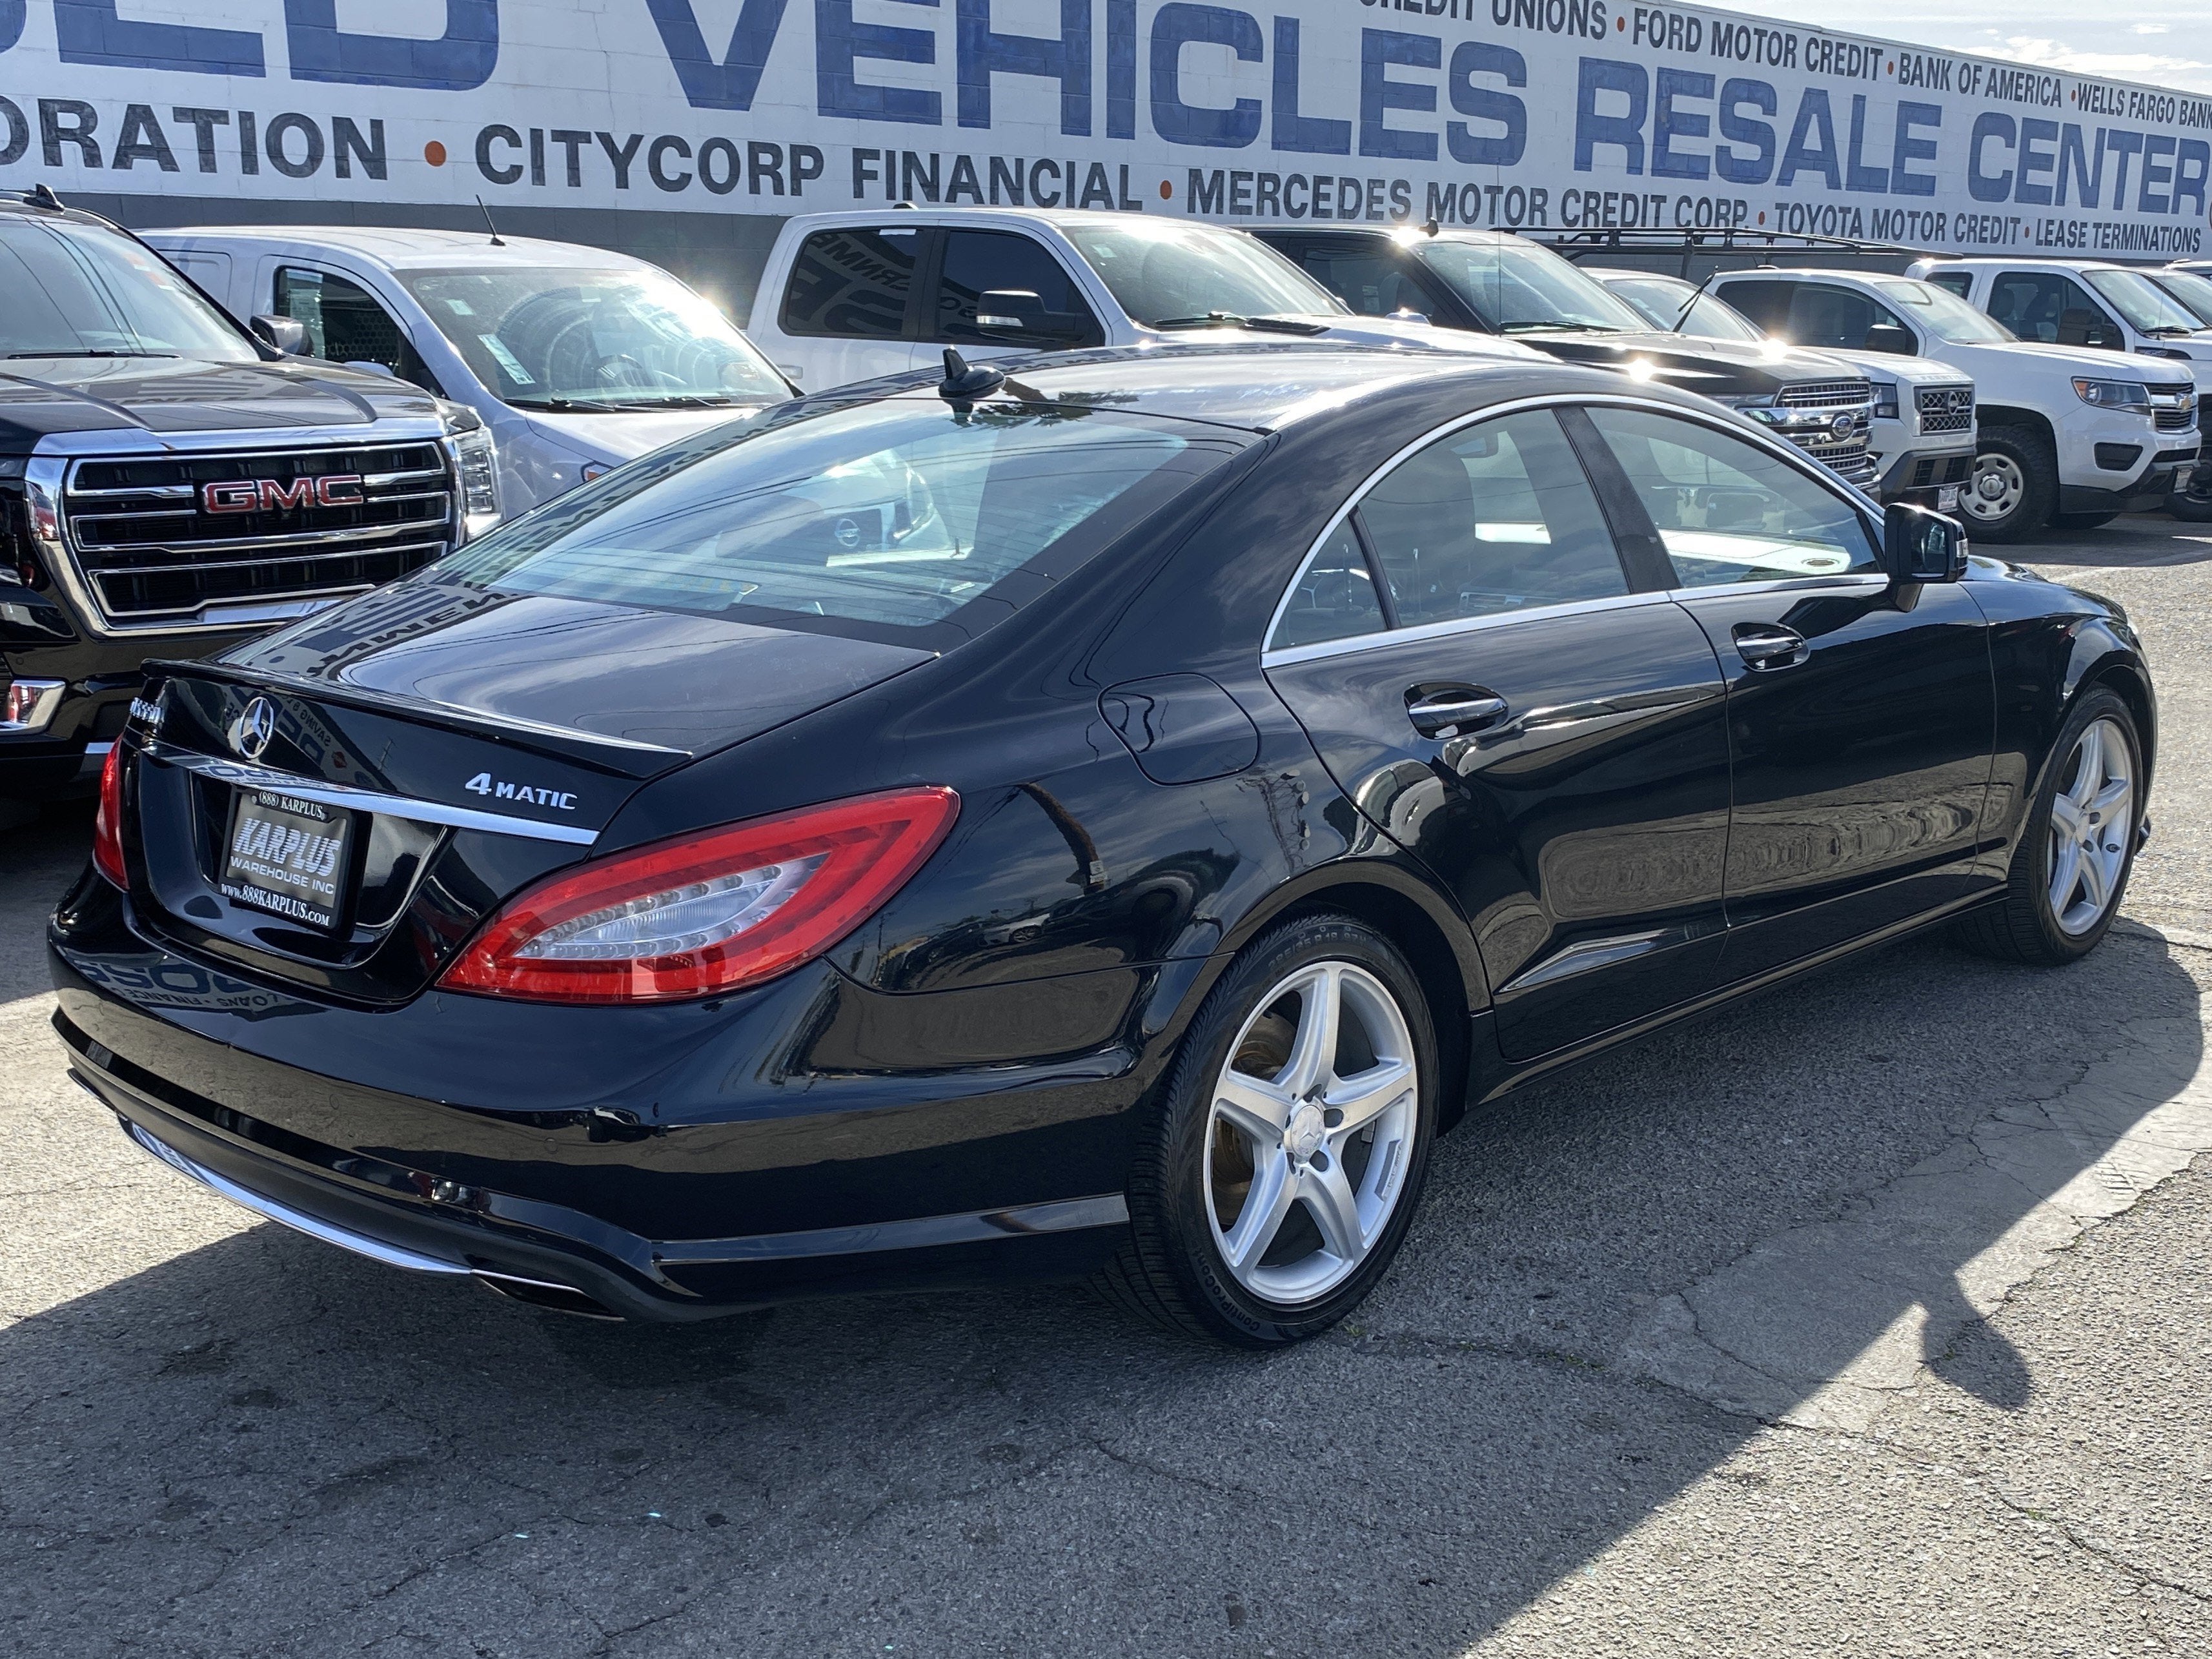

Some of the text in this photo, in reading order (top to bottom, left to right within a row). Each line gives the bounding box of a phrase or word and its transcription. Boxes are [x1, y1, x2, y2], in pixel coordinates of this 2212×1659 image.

[1492, 0, 1607, 39] UNIONS
[1632, 8, 1883, 81] FORD MOTOR CREDIT
[1898, 53, 2062, 108] BANK OF AMERICA
[647, 0, 1527, 166] VEHICLES
[1573, 56, 1942, 196] RESALE
[1967, 112, 2211, 216] CENTER
[2076, 83, 2125, 117] WELLS
[2129, 92, 2175, 123] FARGO
[475, 124, 1142, 211] CITYCORP FINANCIAL
[1188, 168, 1412, 221] MERCEDES
[1426, 181, 1547, 226] MOTOR
[1561, 188, 1667, 228] CREDIT
[1775, 202, 2021, 245] TOYOTA MOTOR CREDIT
[2035, 218, 2201, 253] LEASE TERMINATIONS
[203, 474, 364, 514] GMC
[259, 791, 323, 819] (888) KARPLUS
[465, 773, 578, 809] 4MATIC
[233, 817, 341, 877] KARPLUS
[230, 855, 334, 895] WAREHOUSE INC
